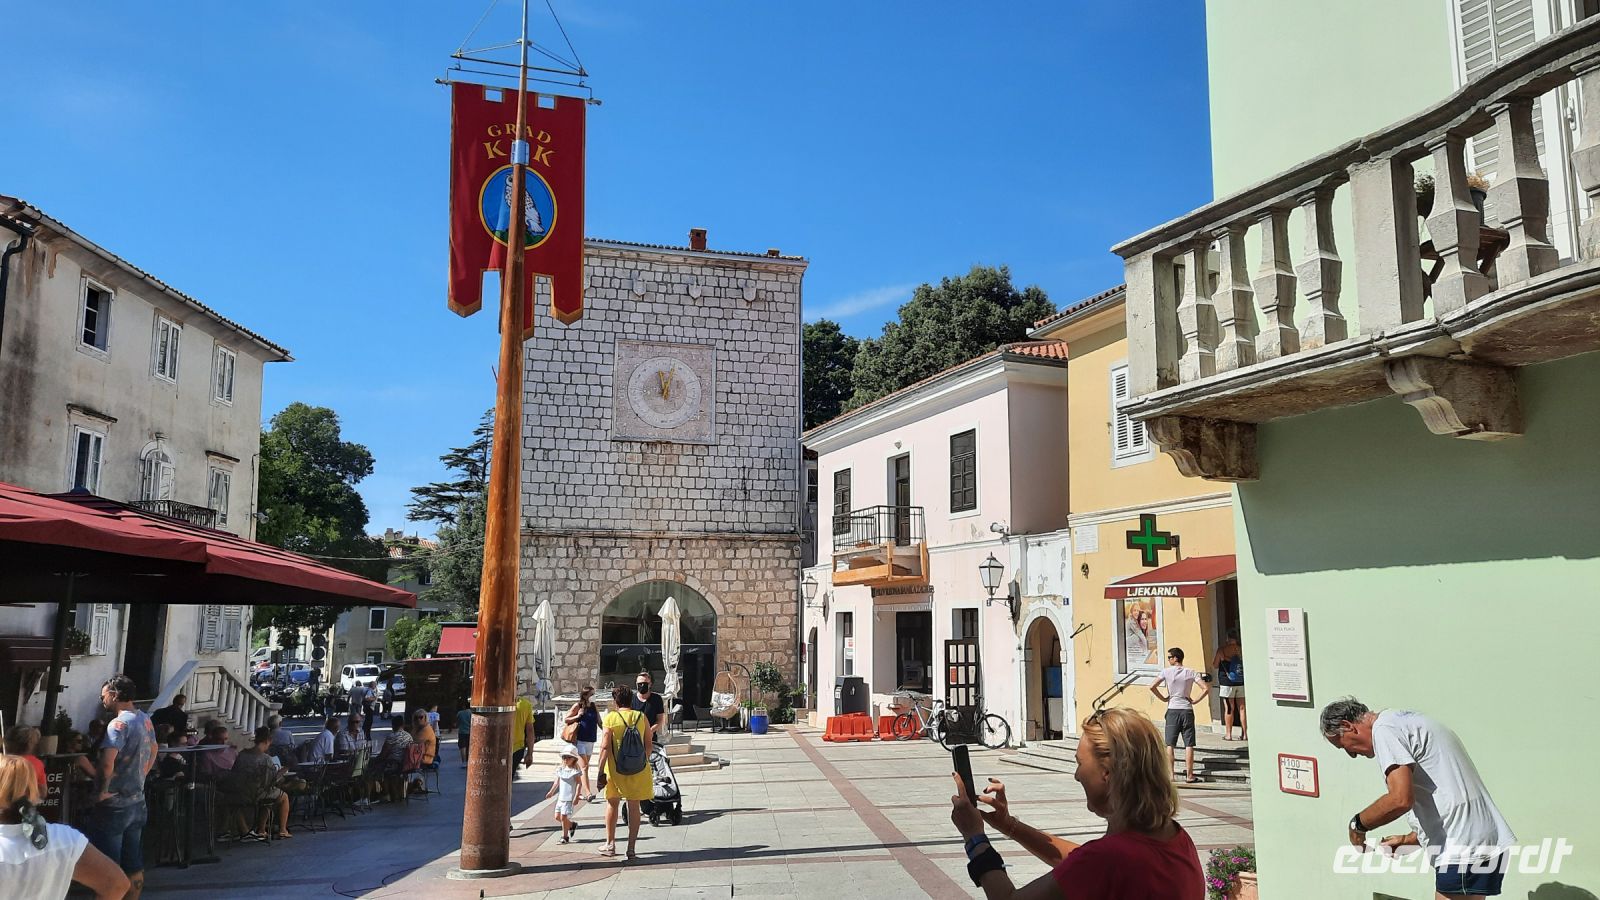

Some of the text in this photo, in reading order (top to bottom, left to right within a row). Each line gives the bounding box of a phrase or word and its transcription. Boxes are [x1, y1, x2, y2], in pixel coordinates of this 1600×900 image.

[482, 139, 556, 168] KK
[1126, 586, 1179, 597] LJEKARNA
[47, 773, 63, 783] GE
